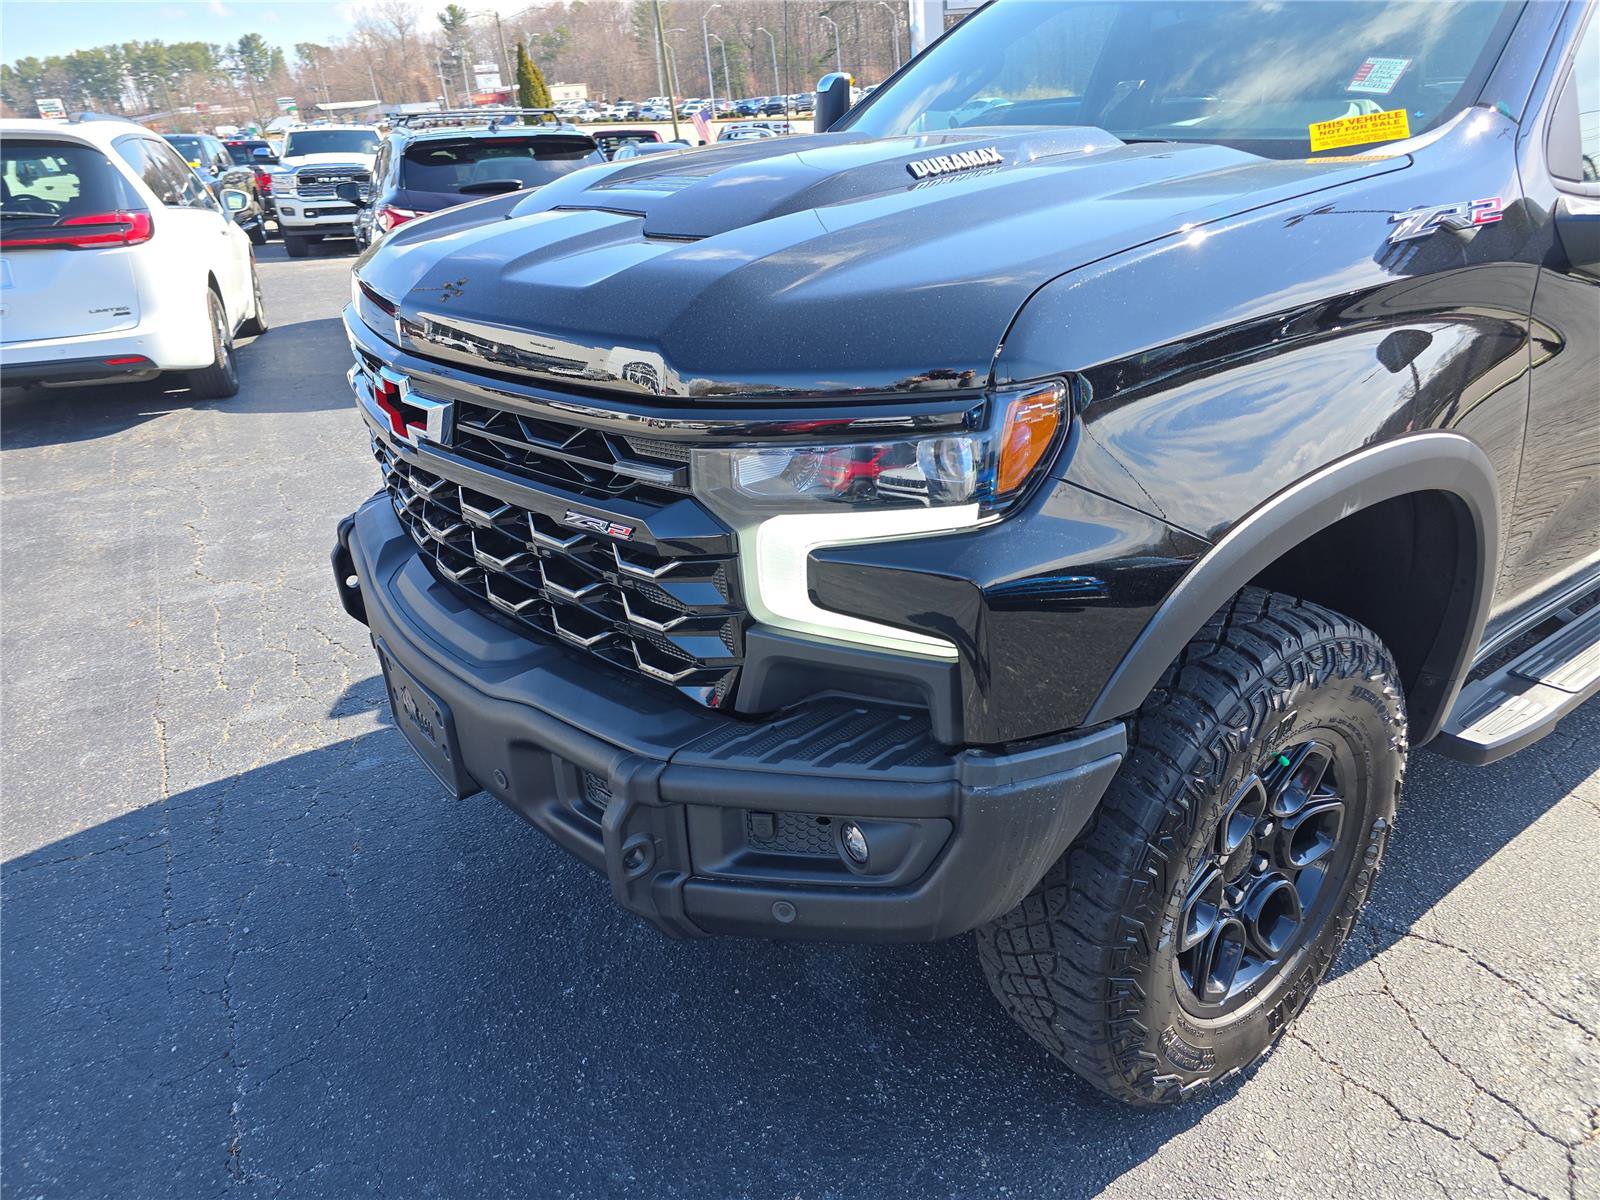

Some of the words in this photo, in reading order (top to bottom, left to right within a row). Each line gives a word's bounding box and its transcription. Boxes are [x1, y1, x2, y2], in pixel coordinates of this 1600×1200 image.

[1316, 120, 1345, 131] THIS
[1347, 111, 1403, 126] VEHICLE
[1319, 129, 1342, 137] NOT
[1345, 124, 1369, 132] FOR
[1371, 118, 1401, 128] SALE
[907, 146, 1004, 179] DURAMAX
[1387, 197, 1503, 244] ZR2
[564, 511, 632, 540] ZR2
